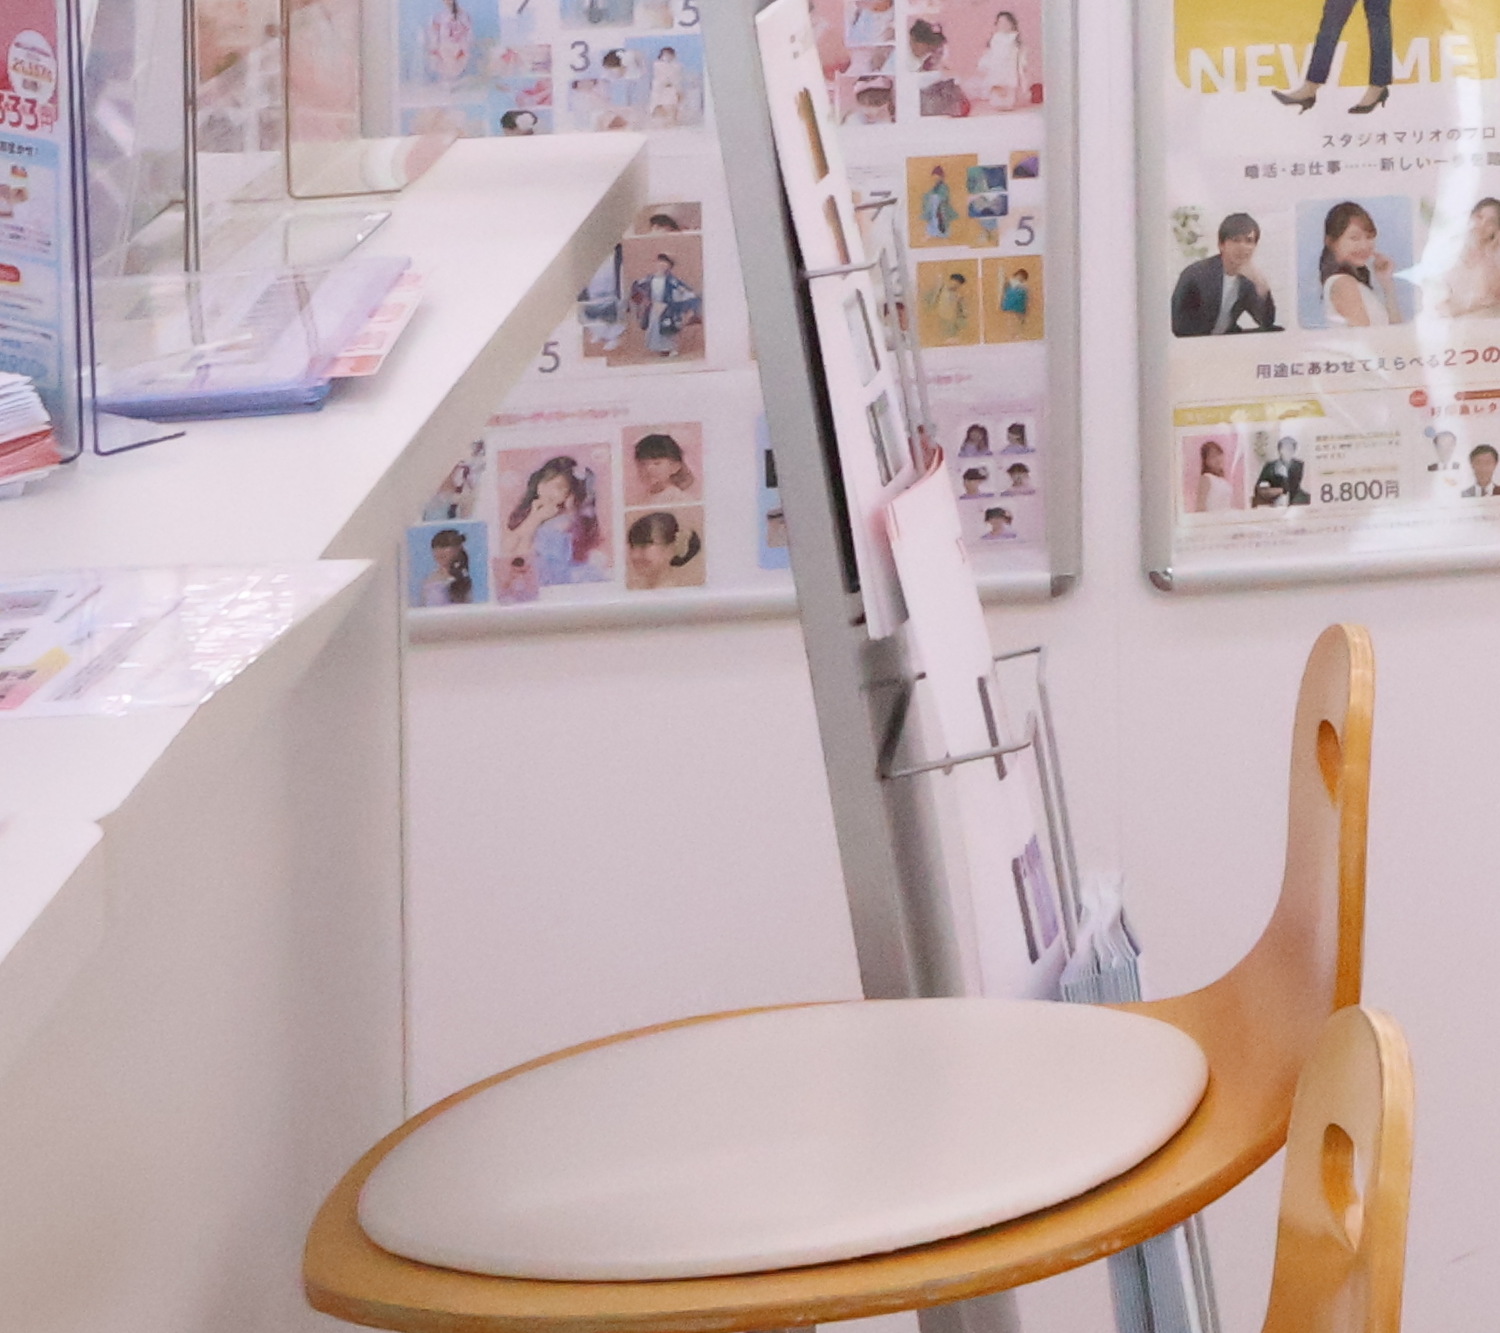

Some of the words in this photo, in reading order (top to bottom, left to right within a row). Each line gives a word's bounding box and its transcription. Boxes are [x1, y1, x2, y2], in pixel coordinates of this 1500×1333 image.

[568, 41, 591, 72] 3
[1189, 41, 1348, 93] NEW
[1013, 216, 1036, 246] 5
[538, 341, 561, 373] 5
